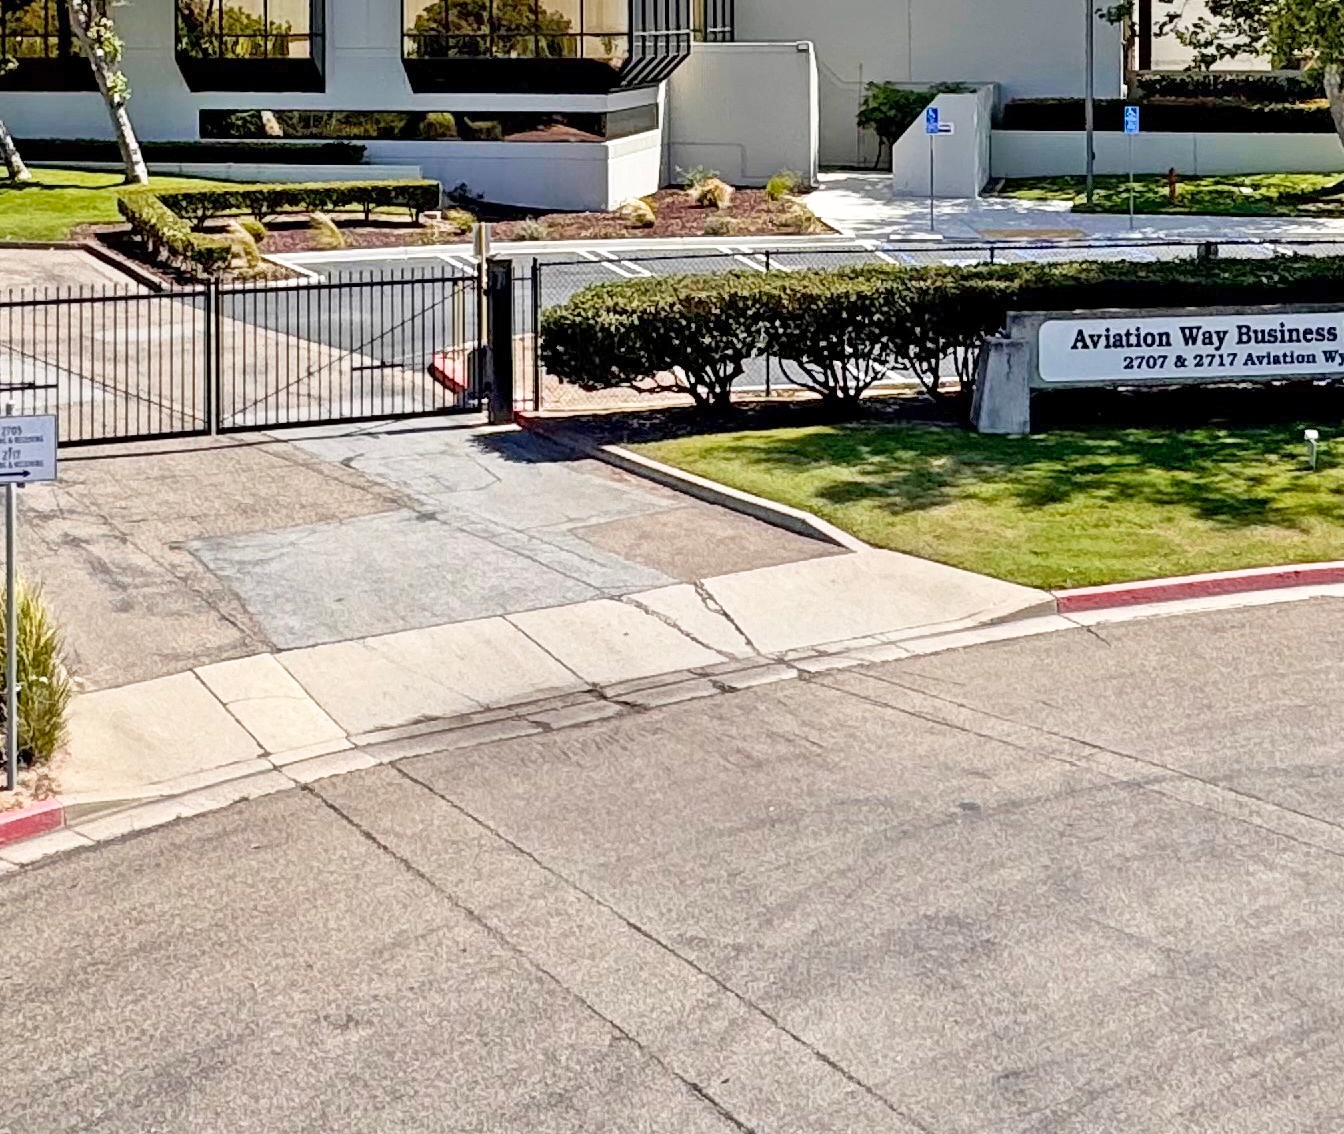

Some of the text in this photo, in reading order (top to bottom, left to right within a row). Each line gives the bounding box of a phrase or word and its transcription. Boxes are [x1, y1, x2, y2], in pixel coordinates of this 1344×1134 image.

[1070, 326, 1172, 349] Aviation
[1179, 325, 1229, 351] Way
[1236, 321, 1338, 344] Business
[1123, 355, 1168, 370] 2707
[1174, 354, 1187, 368] &
[1193, 352, 1238, 368] 2717
[1243, 350, 1317, 366] Aviation
